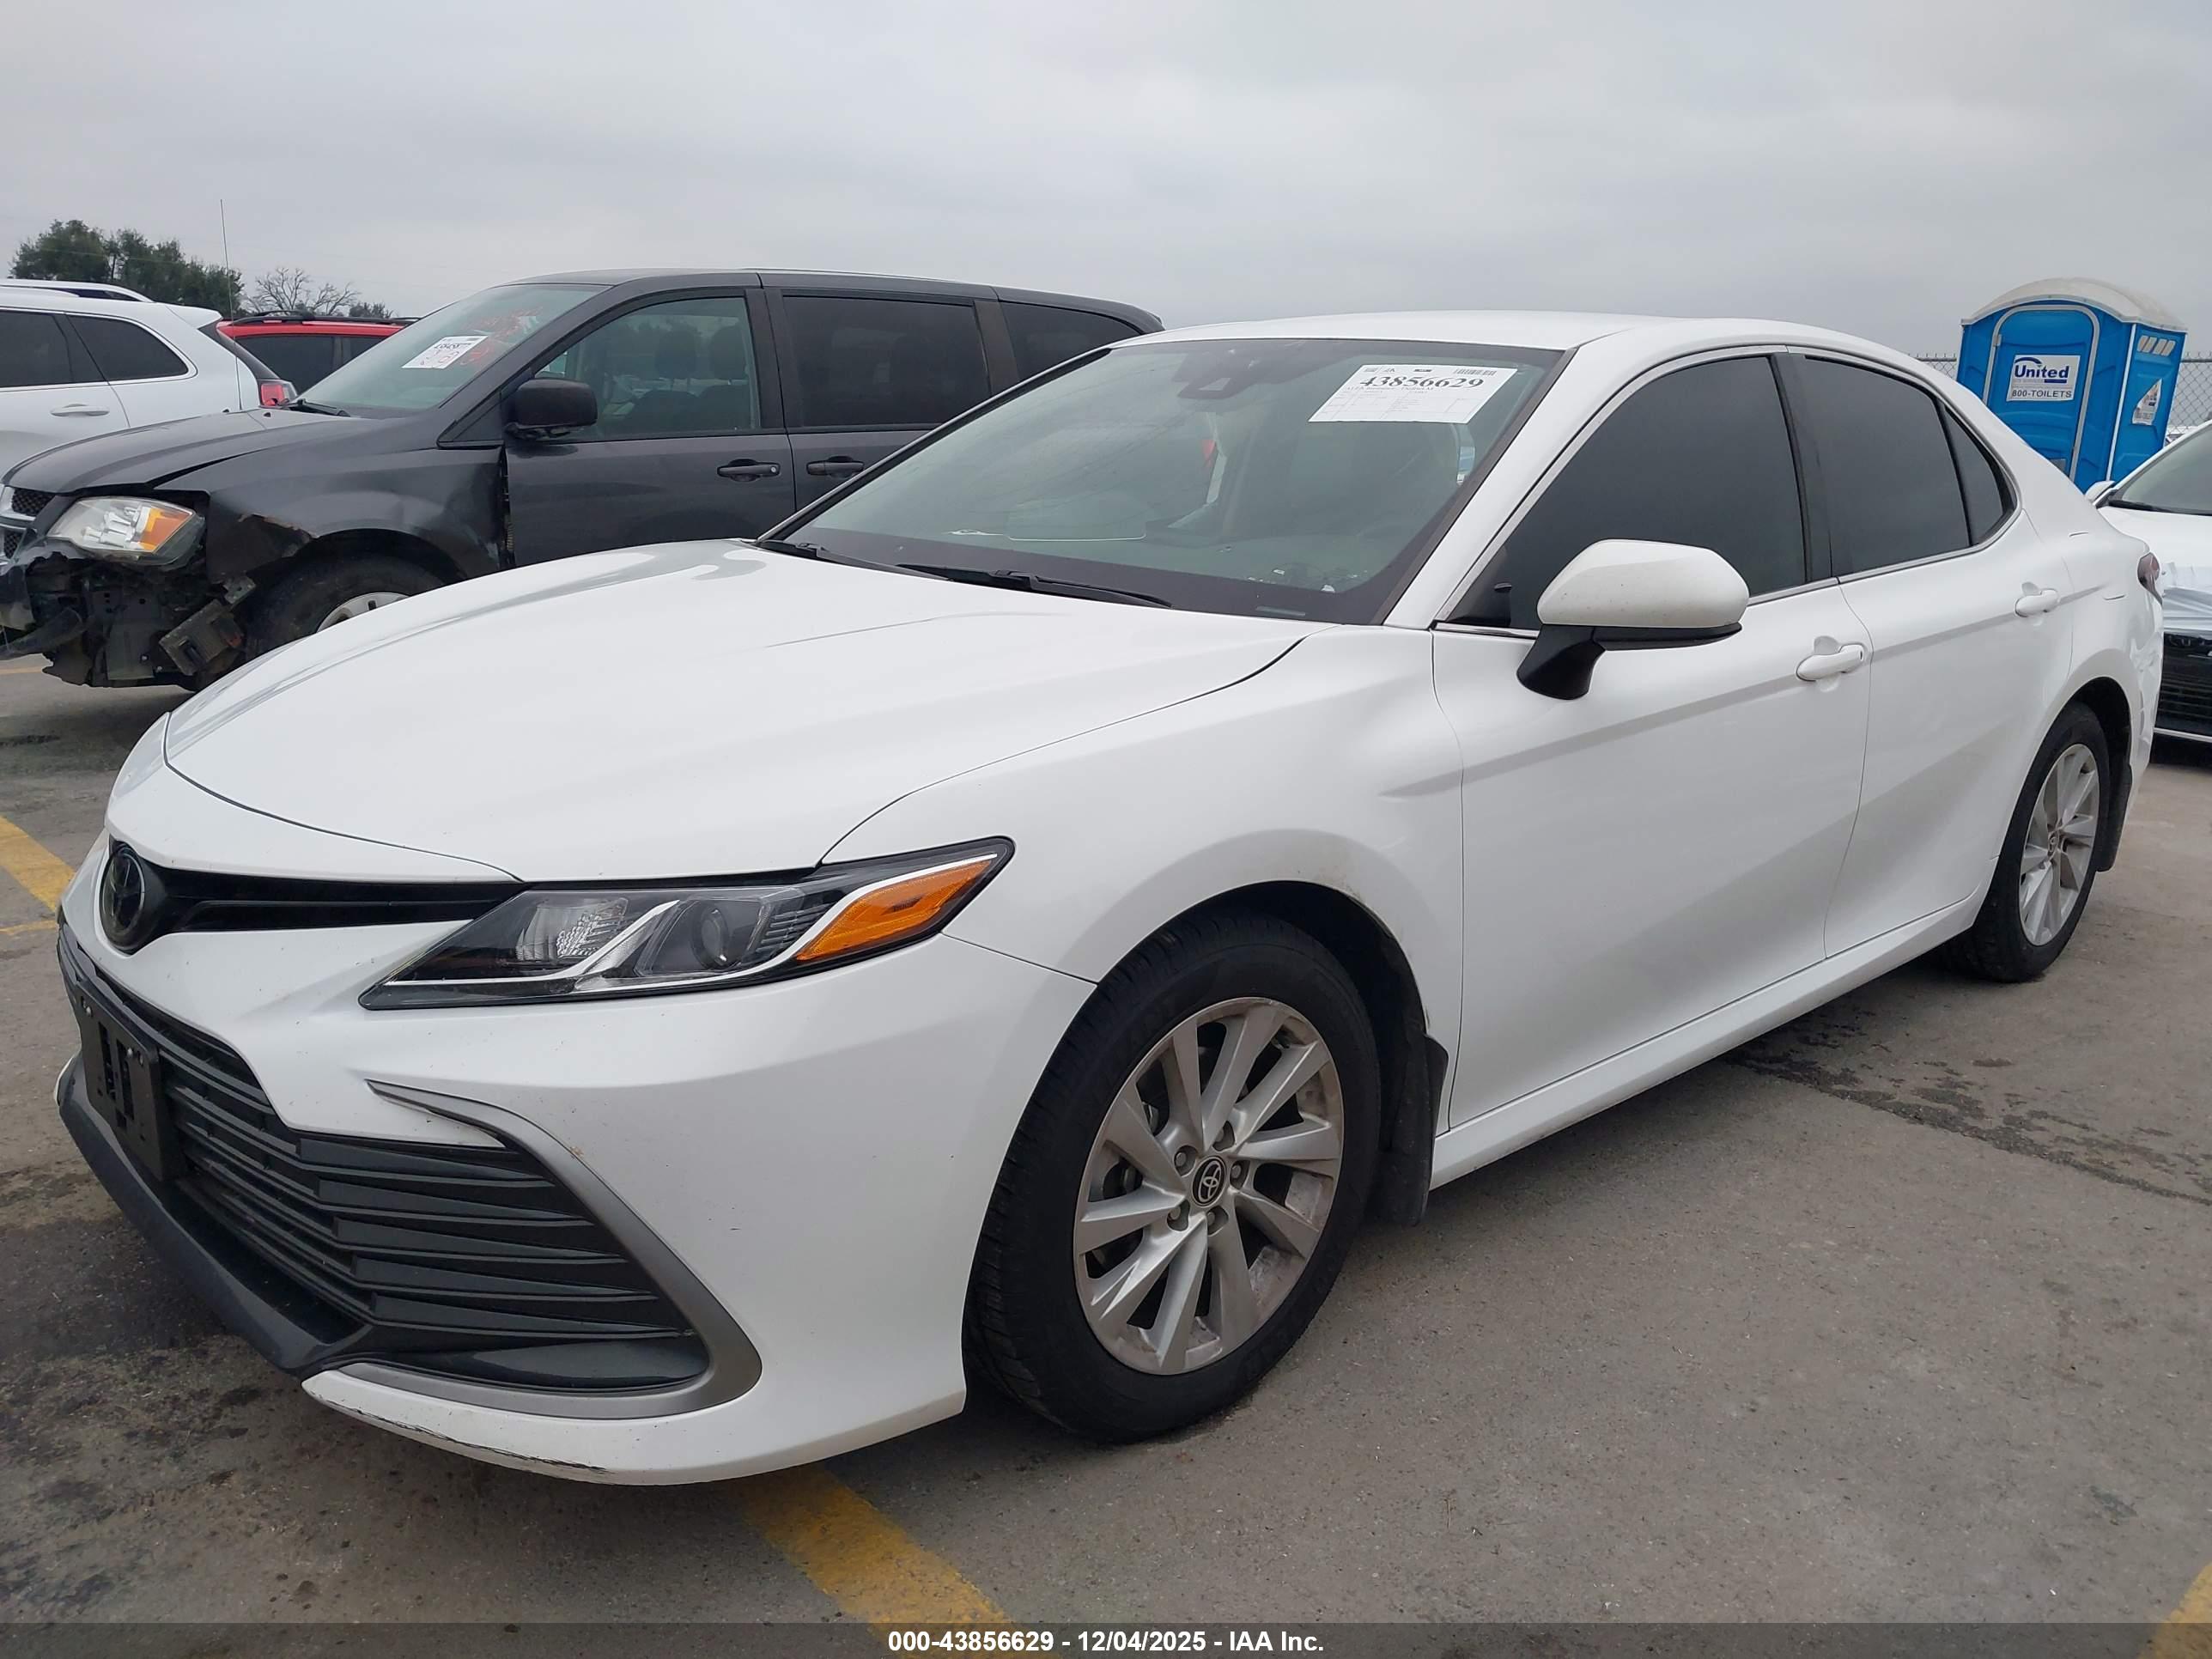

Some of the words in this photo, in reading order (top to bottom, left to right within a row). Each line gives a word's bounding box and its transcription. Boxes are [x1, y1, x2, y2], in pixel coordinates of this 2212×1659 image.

[2014, 365, 2069, 379] United
[1360, 376, 1484, 388] 43856629
[2012, 389, 2072, 398] 800-TOILETS
